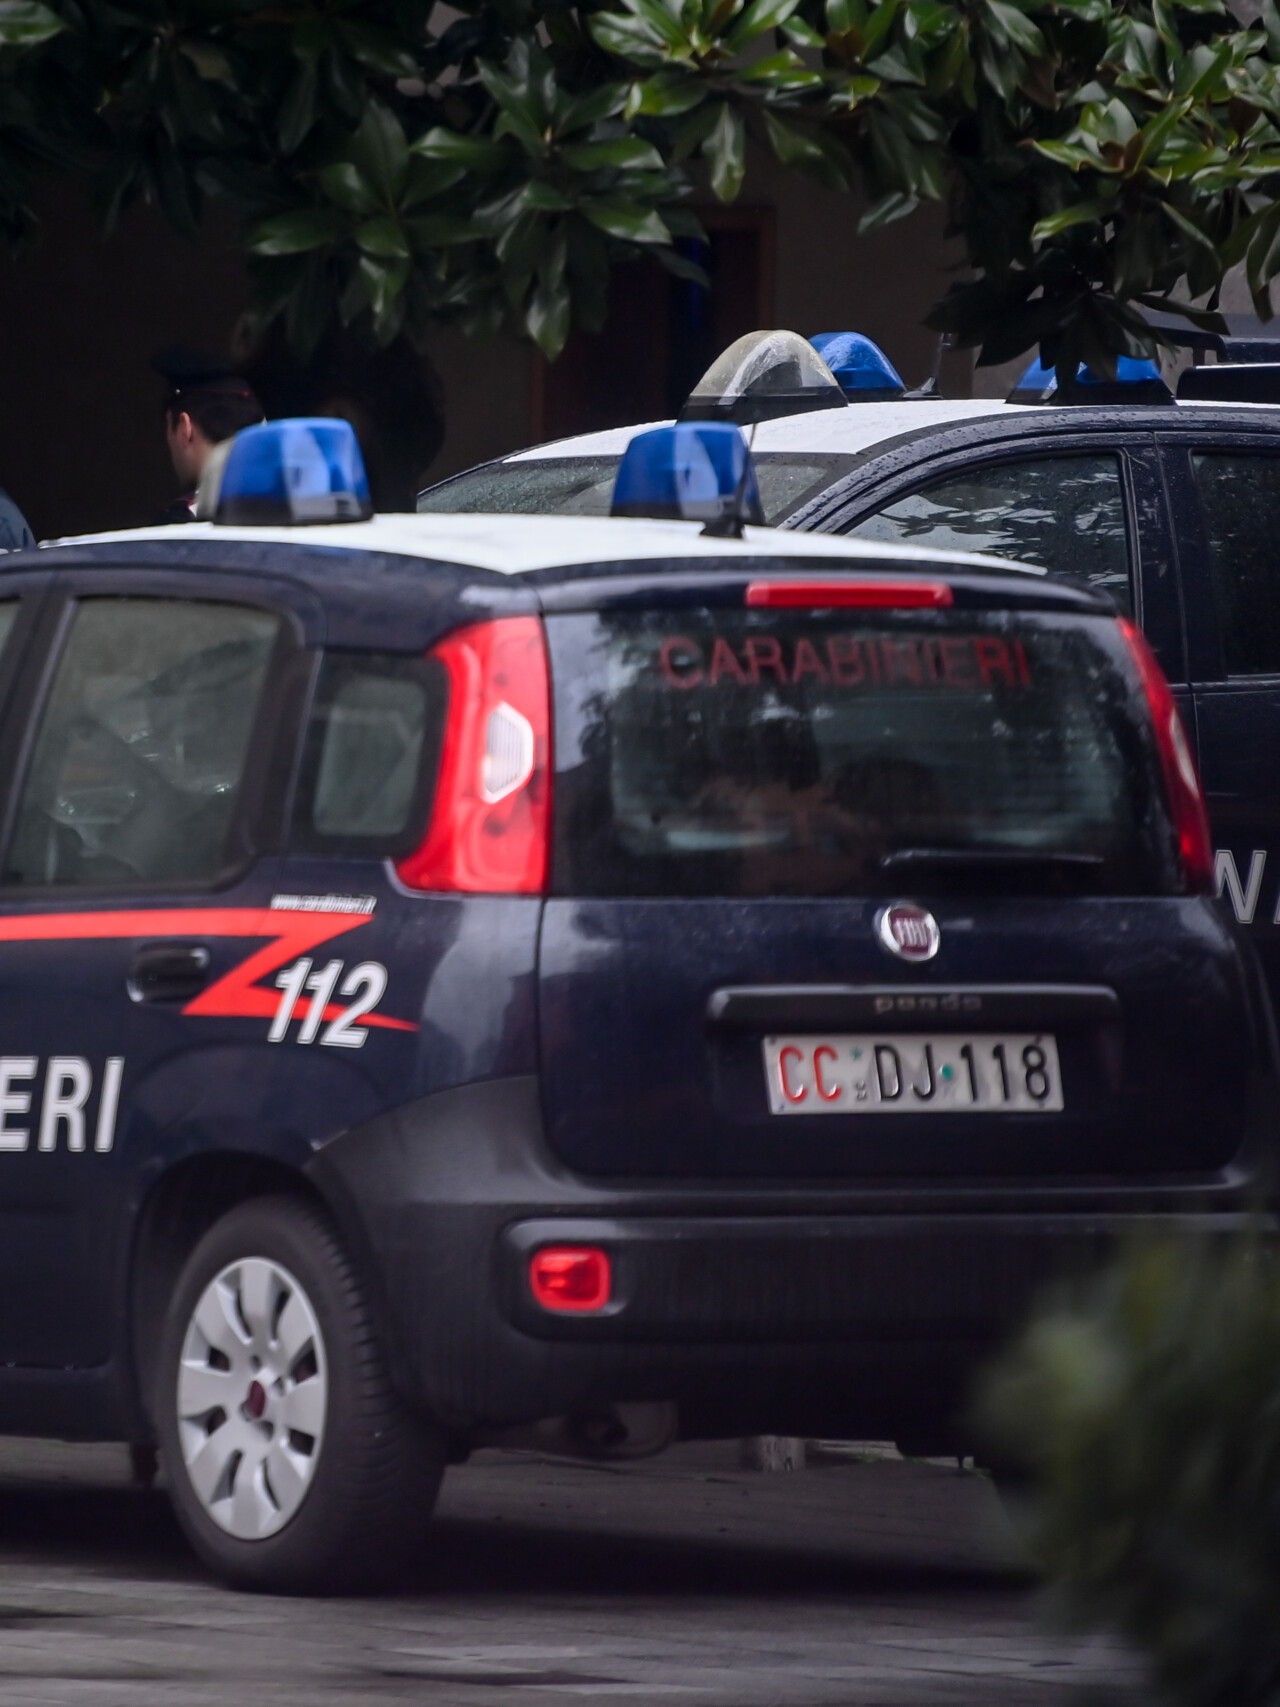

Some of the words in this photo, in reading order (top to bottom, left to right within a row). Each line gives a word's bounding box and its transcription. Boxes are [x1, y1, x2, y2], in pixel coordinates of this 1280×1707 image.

[660, 634, 1031, 690] CARABINIERI
[1214, 849, 1280, 924] N
[267, 957, 388, 1048] 112
